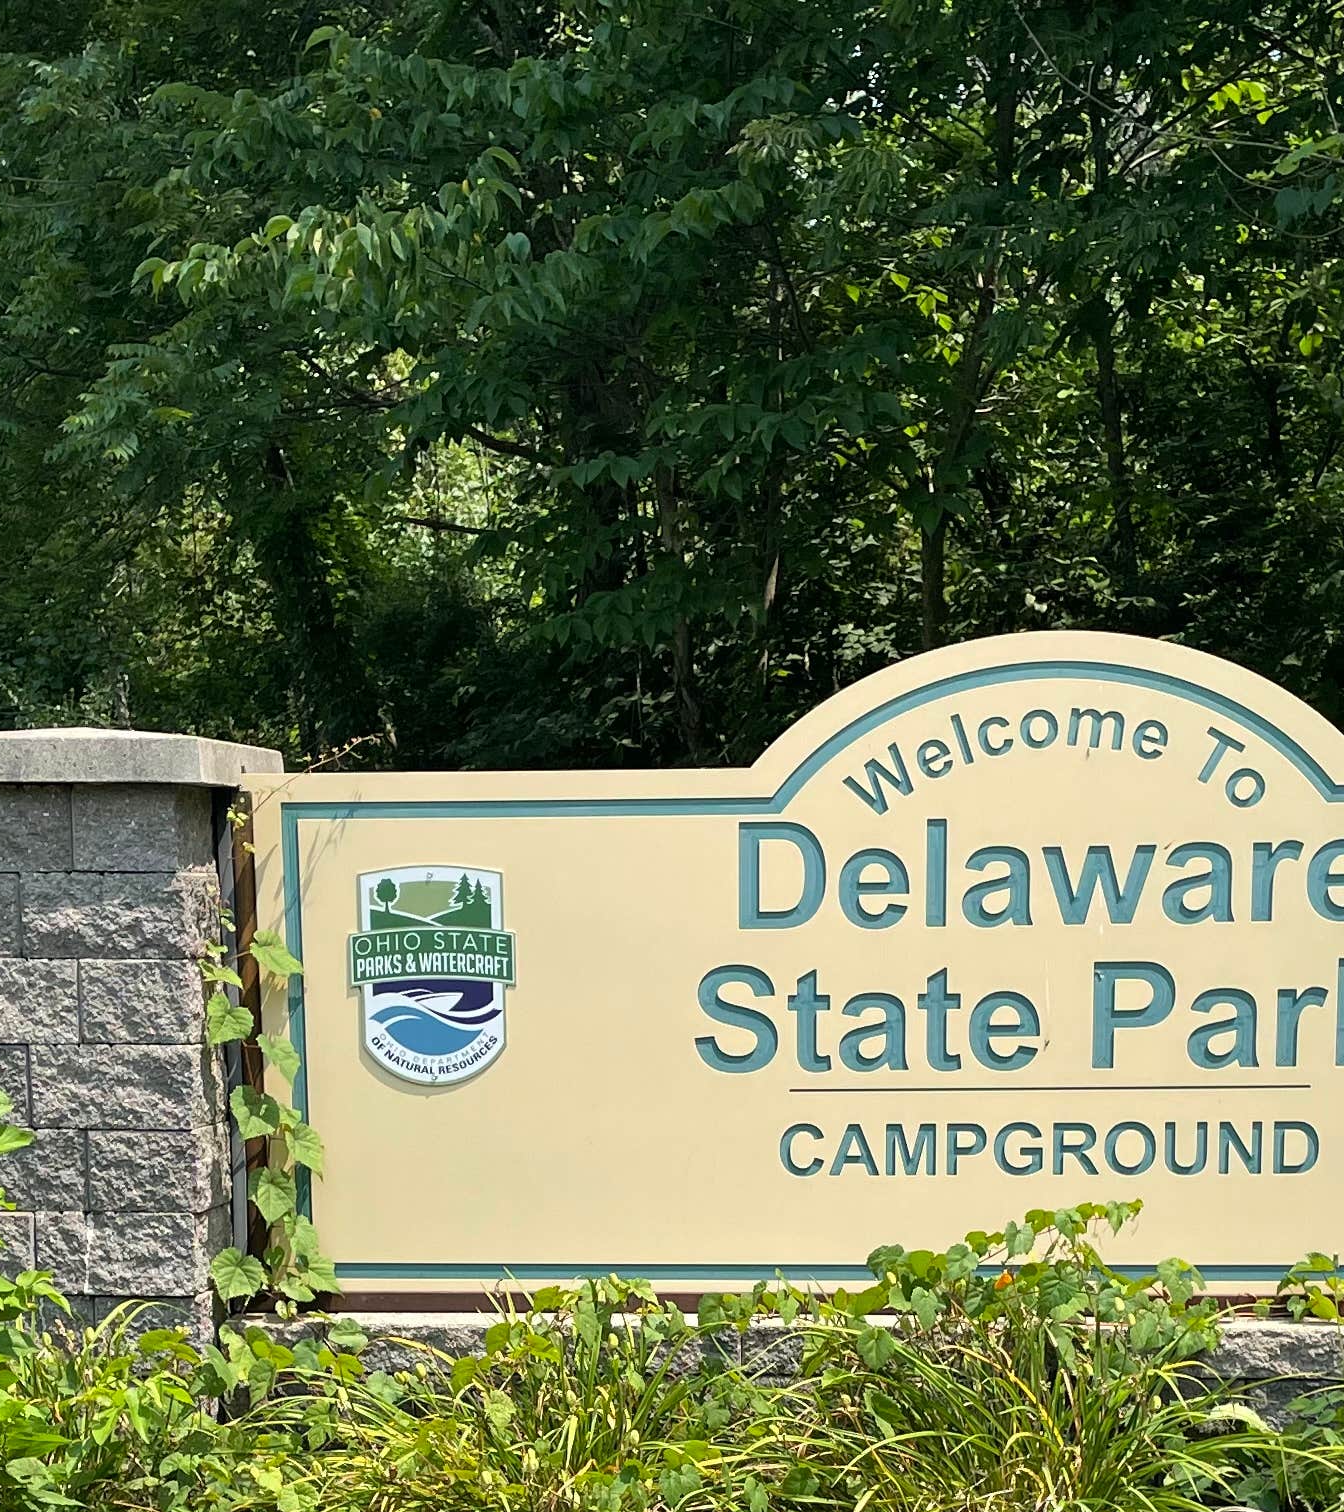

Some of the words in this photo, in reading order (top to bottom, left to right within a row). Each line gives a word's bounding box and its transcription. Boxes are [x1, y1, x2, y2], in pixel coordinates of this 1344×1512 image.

[842, 706, 1170, 816] Welcome
[1196, 725, 1266, 809] To
[354, 932, 421, 955] OHIO
[433, 931, 509, 955] STATE
[356, 954, 402, 979] PARKS
[405, 954, 417, 972] &
[419, 952, 509, 977] WATERCRAFT
[693, 964, 1042, 1074] State
[371, 1036, 387, 1051] OF
[383, 1049, 436, 1076] NATURAL
[437, 1035, 499, 1076] RESOURCES
[379, 1032, 407, 1057] OHIO
[412, 1031, 491, 1065] DEPARTMENT
[778, 1120, 1321, 1177] CAMPGROUND
